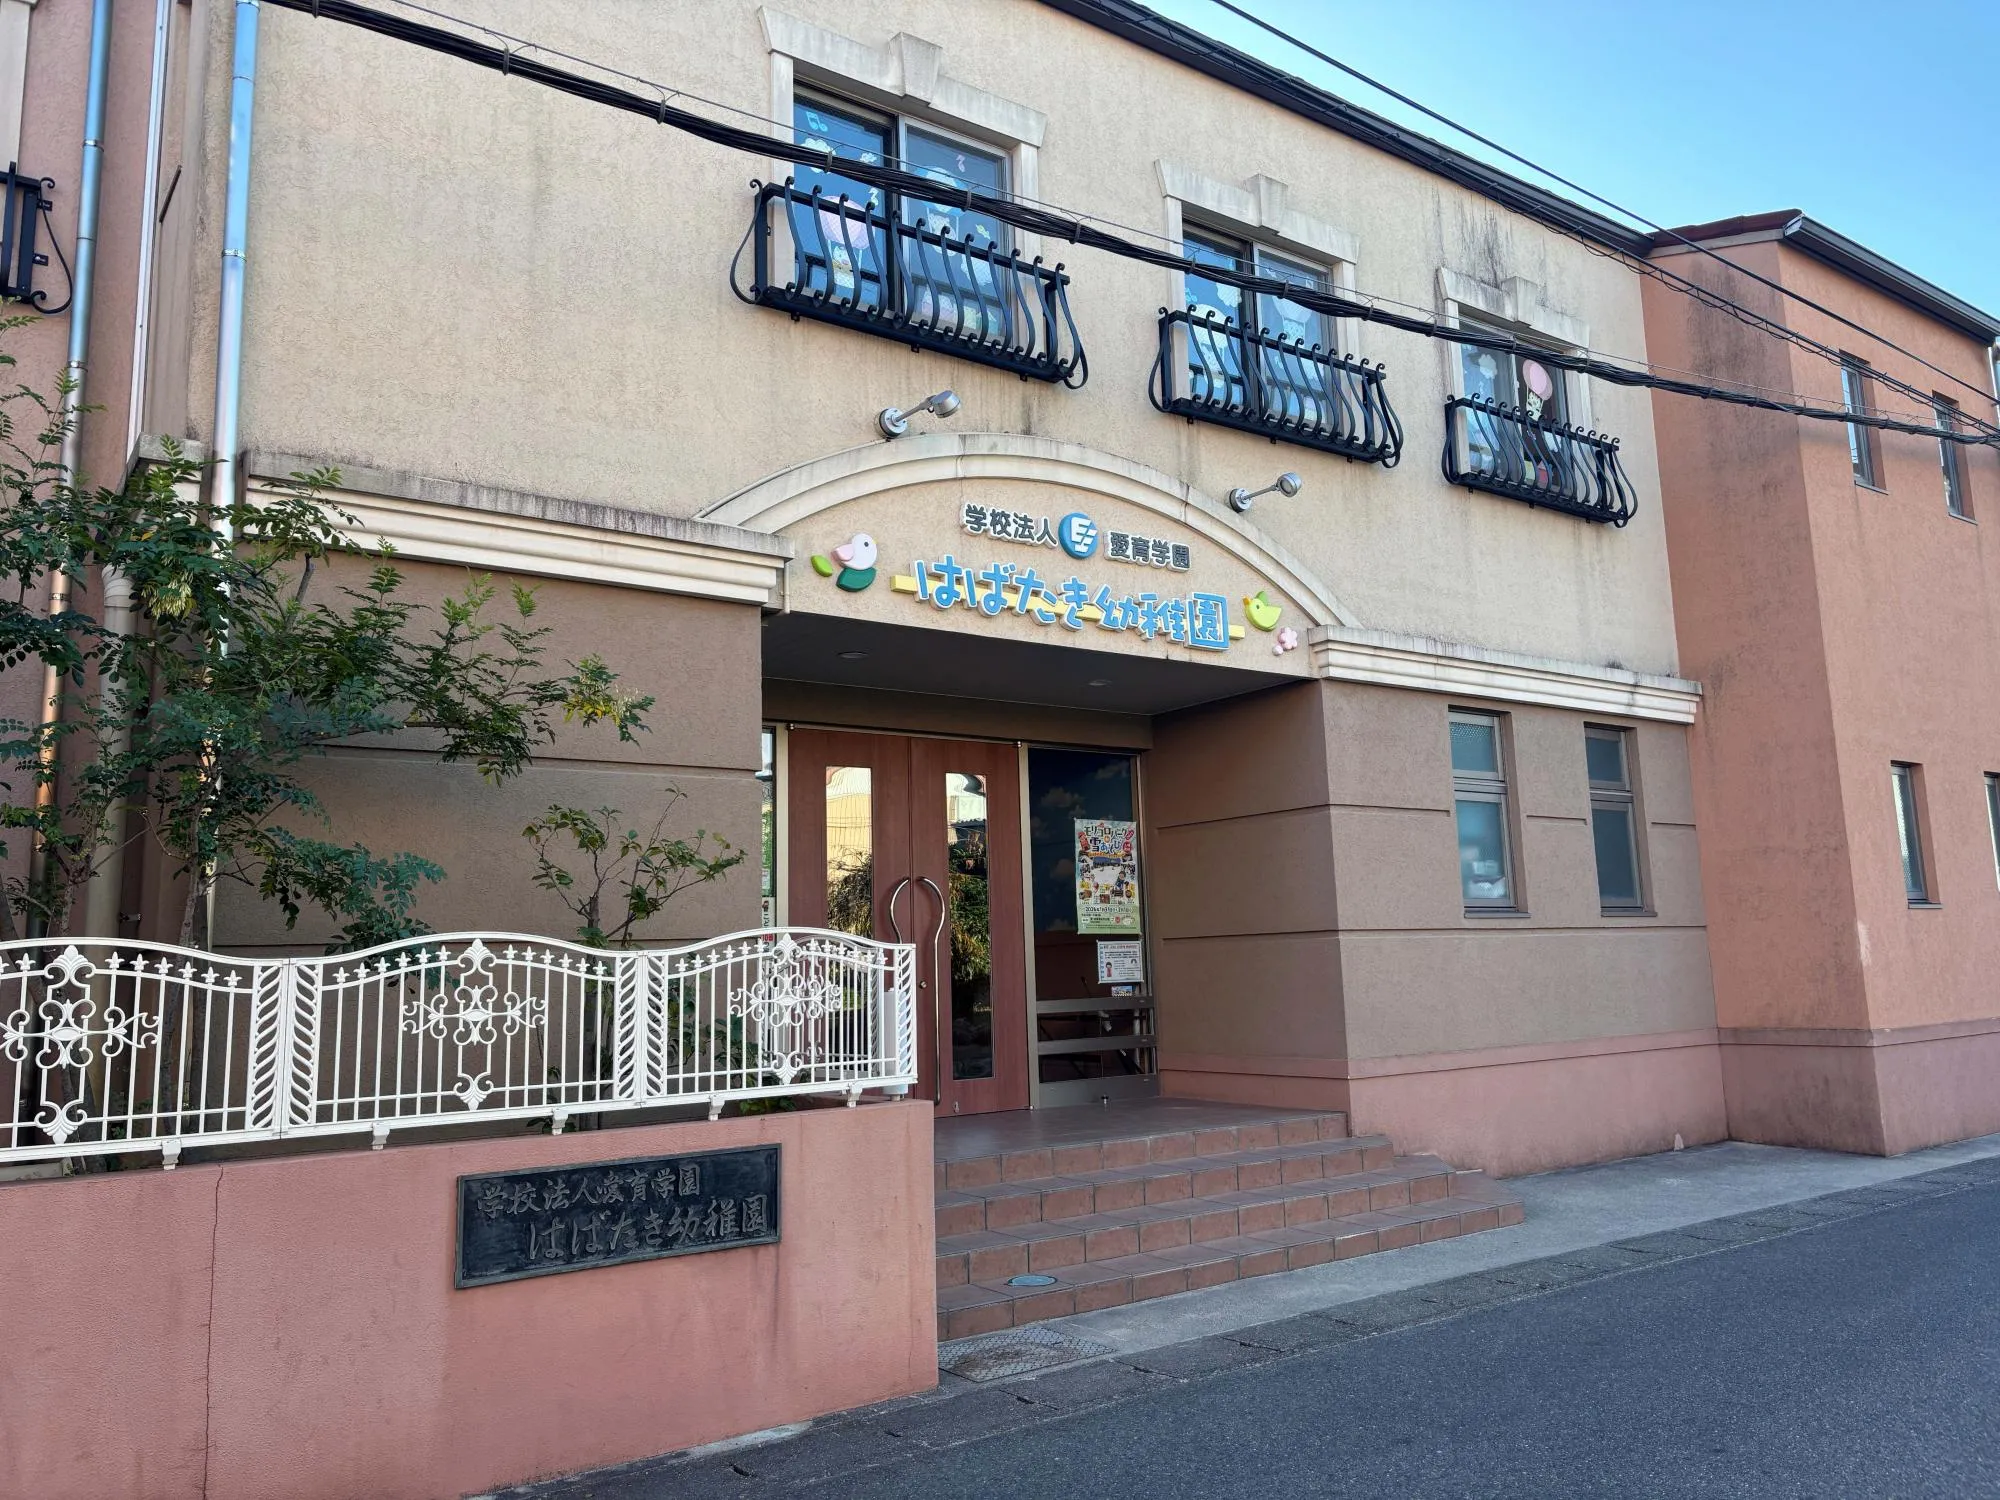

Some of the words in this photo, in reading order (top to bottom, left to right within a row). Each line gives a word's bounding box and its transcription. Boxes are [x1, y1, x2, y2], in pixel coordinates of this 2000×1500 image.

[964, 503, 1058, 546] 学校法人
[1109, 531, 1191, 570] 愛育学園
[915, 554, 1230, 650] はばたき幼稚園
[477, 1163, 701, 1219] 学校法人愛育学園
[528, 1193, 769, 1261] はばたき幼稚園
